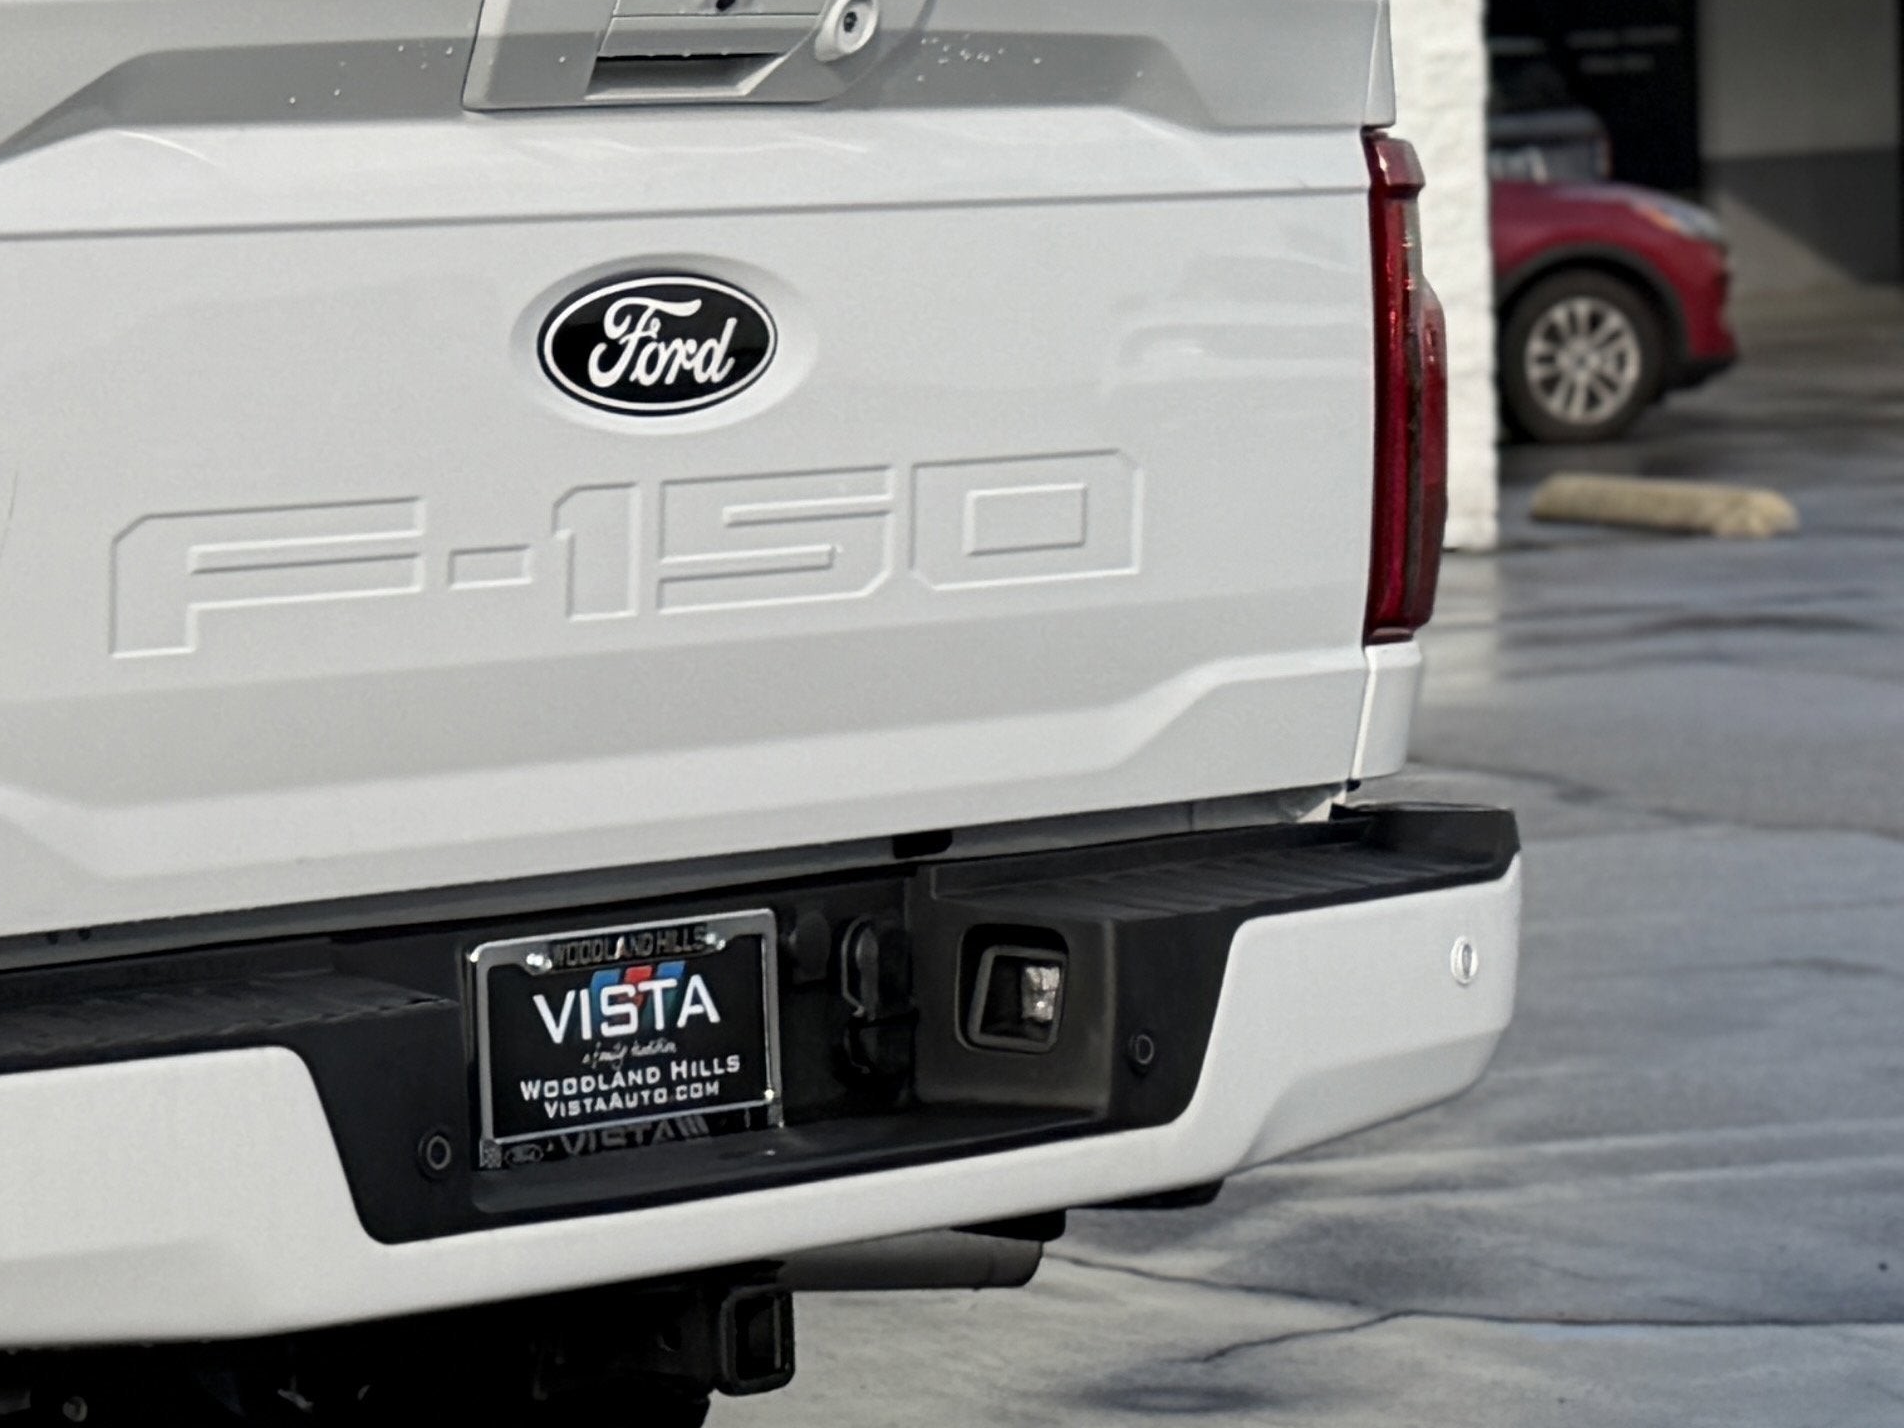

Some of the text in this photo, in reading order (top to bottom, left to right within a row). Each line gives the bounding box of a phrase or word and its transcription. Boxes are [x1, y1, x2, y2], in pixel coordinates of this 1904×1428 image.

[587, 296, 738, 388] Ford
[110, 448, 1144, 659] F-150
[532, 974, 721, 1045] VISTA
